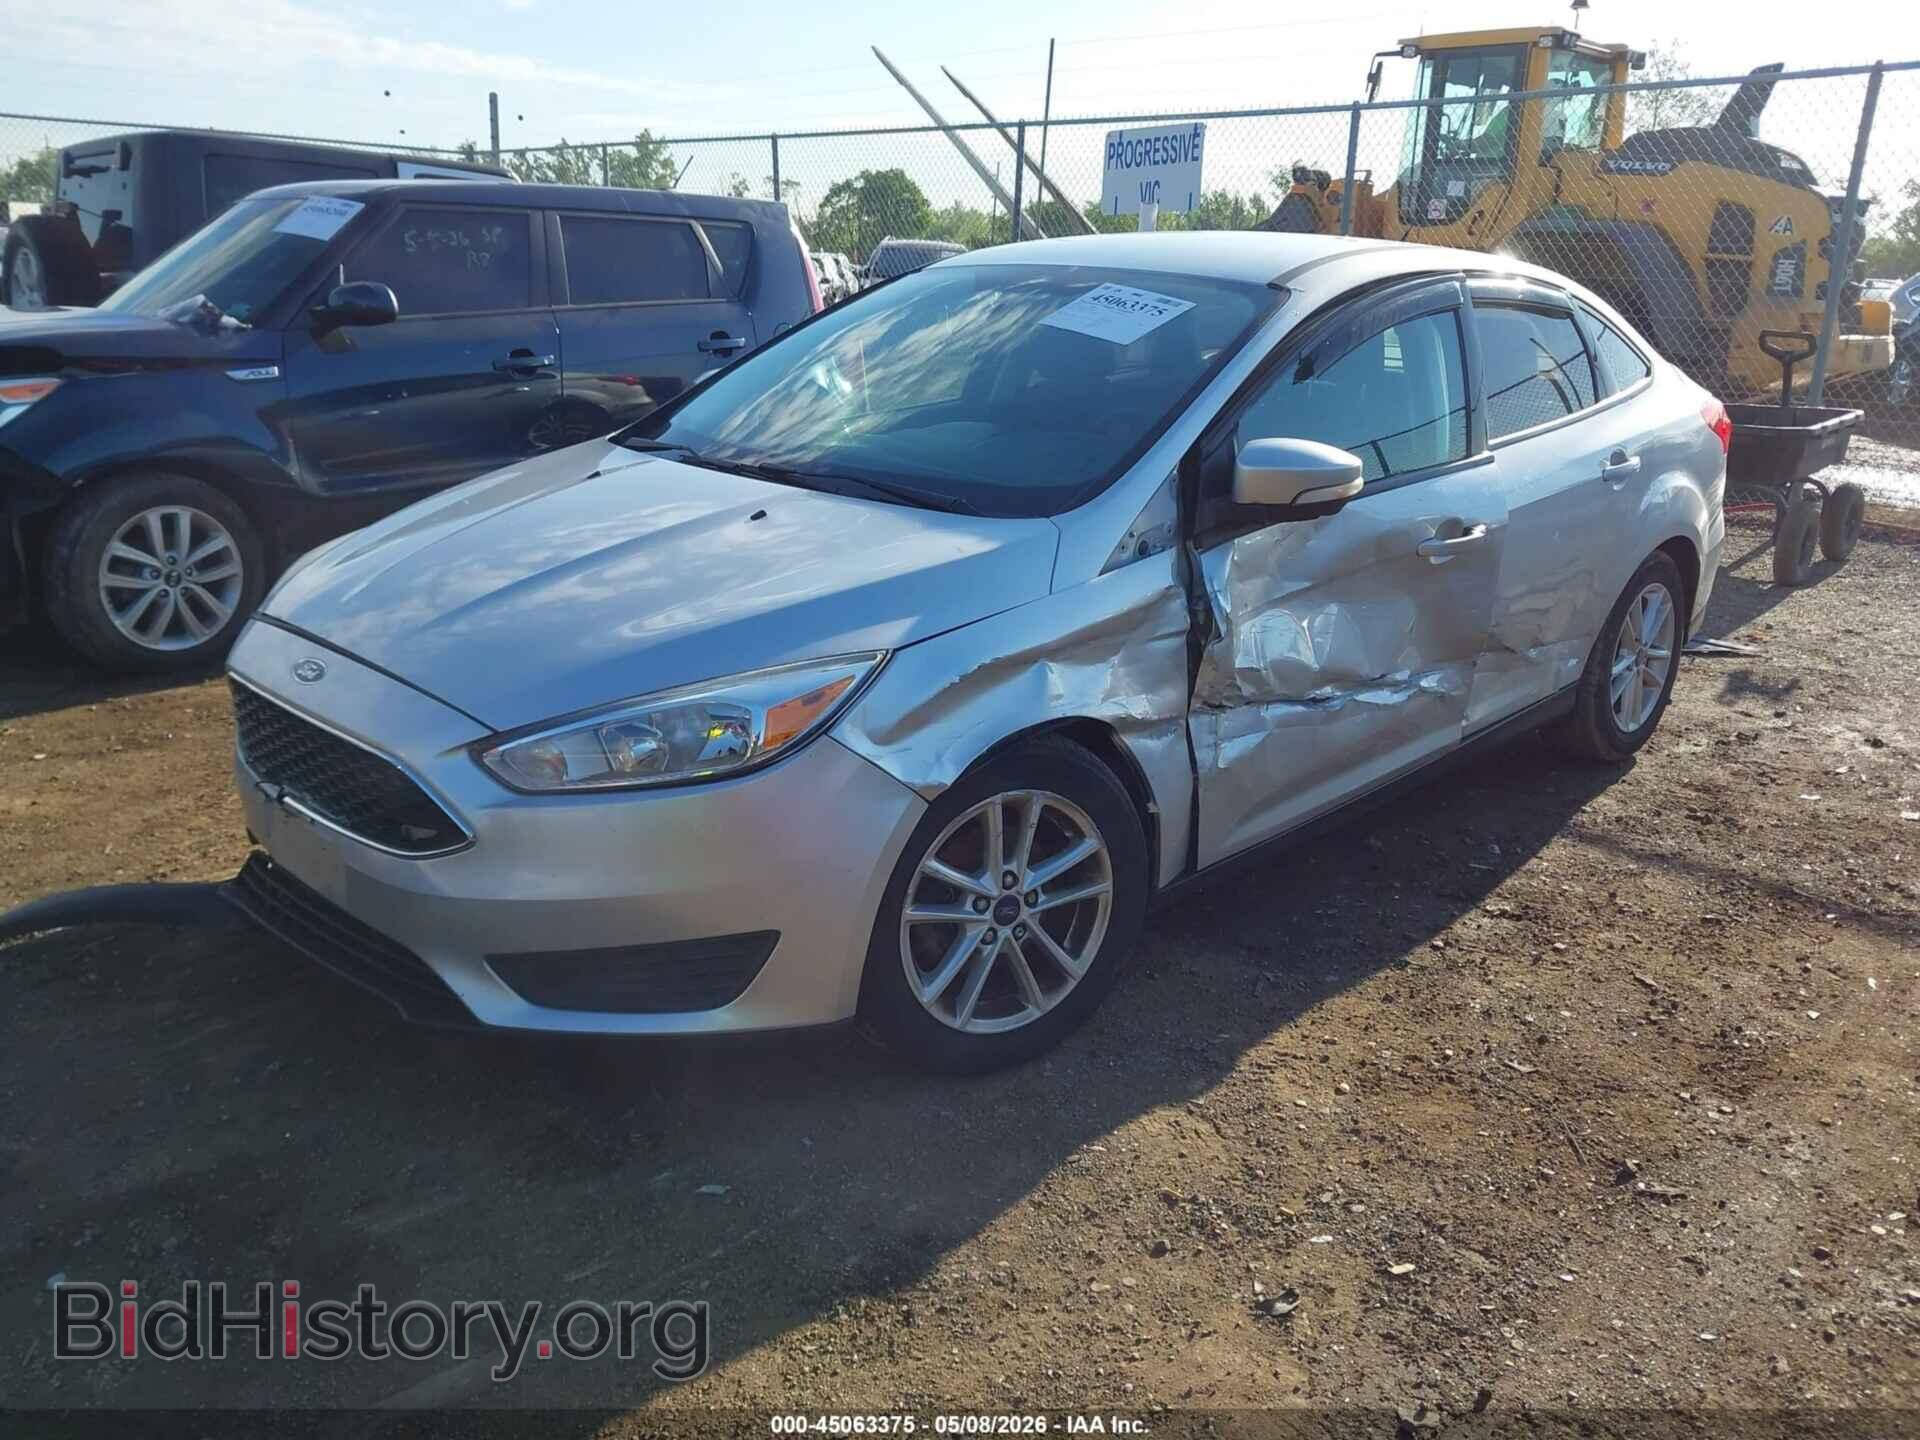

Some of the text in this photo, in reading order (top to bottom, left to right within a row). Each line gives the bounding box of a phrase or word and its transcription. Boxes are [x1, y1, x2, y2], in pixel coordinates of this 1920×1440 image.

[1107, 130, 1200, 170] PROGRESSIVE
[1608, 159, 1671, 171] VOLVO
[1139, 180, 1161, 204] VIC
[1090, 293, 1169, 317] 45063375
